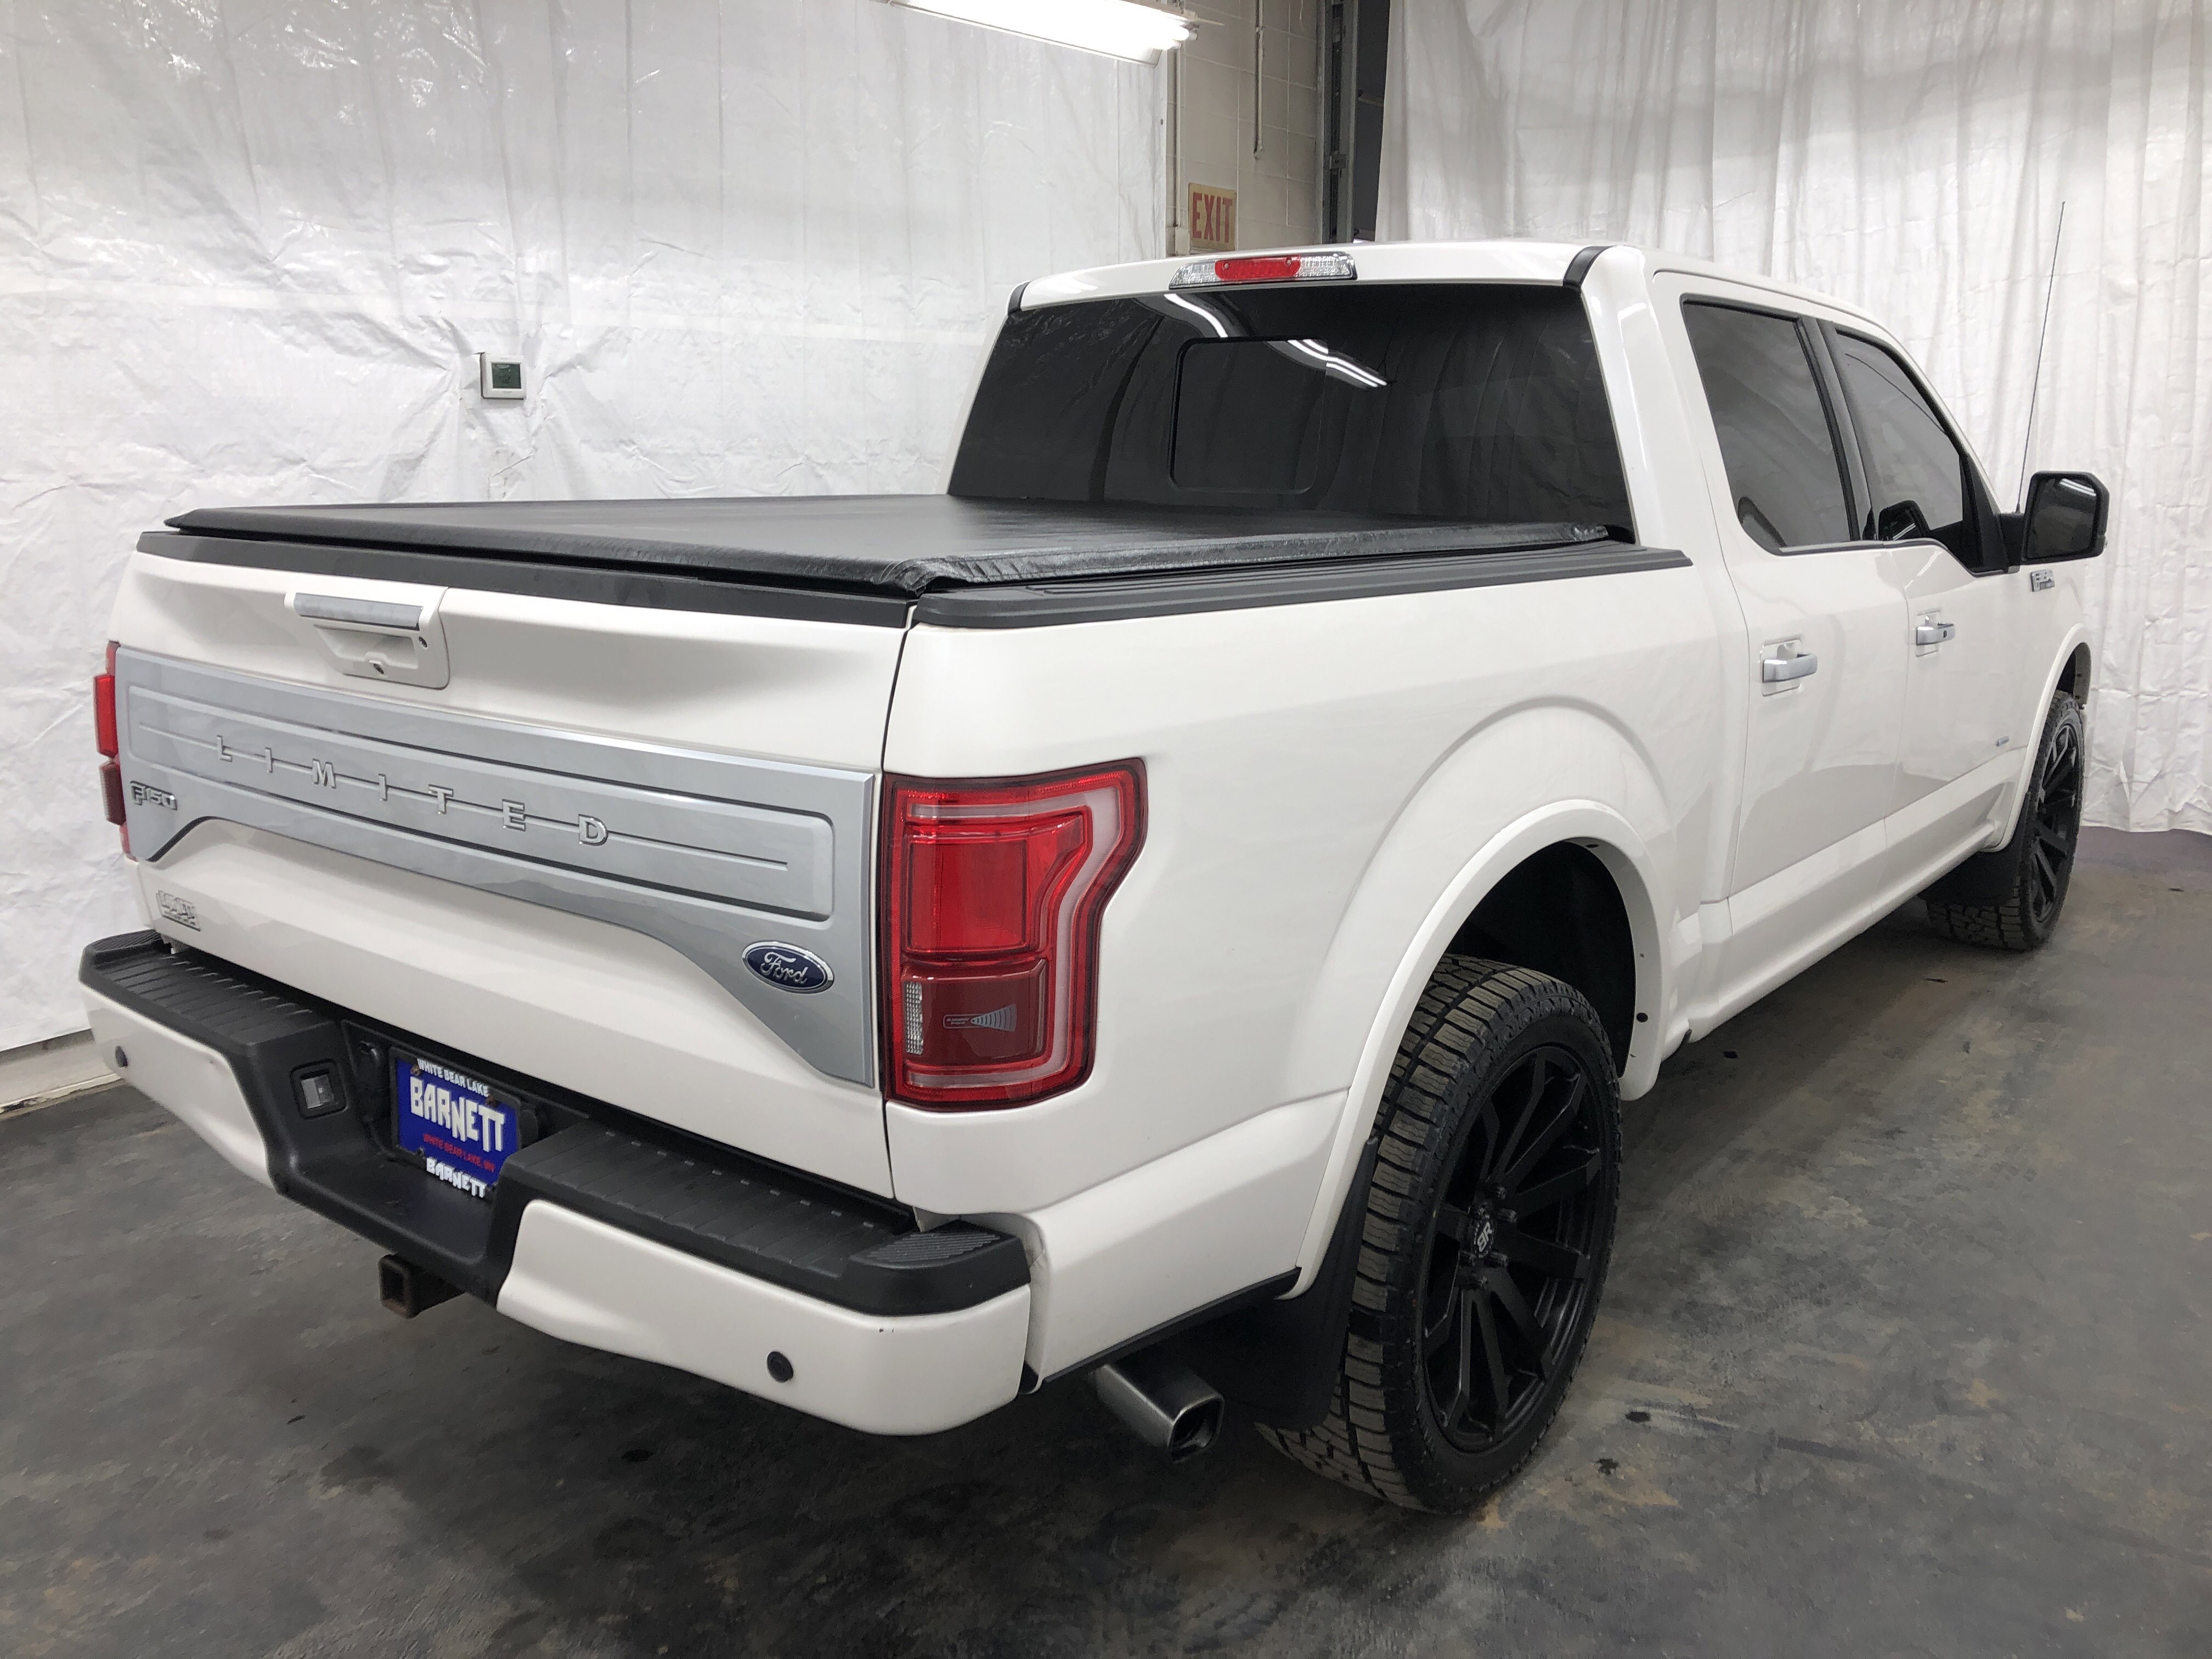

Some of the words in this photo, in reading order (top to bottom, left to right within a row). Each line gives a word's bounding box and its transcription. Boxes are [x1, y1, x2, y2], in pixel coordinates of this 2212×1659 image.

[1192, 192, 1233, 243] EXIT
[217, 735, 608, 846] LIMITED
[760, 951, 809, 984] Ford
[417, 1058, 443, 1078] WHITE
[444, 1069, 466, 1088] BEAR
[467, 1079, 489, 1098] LAKE
[410, 1076, 505, 1153] BARNETT
[426, 1157, 487, 1198] BARNETT
